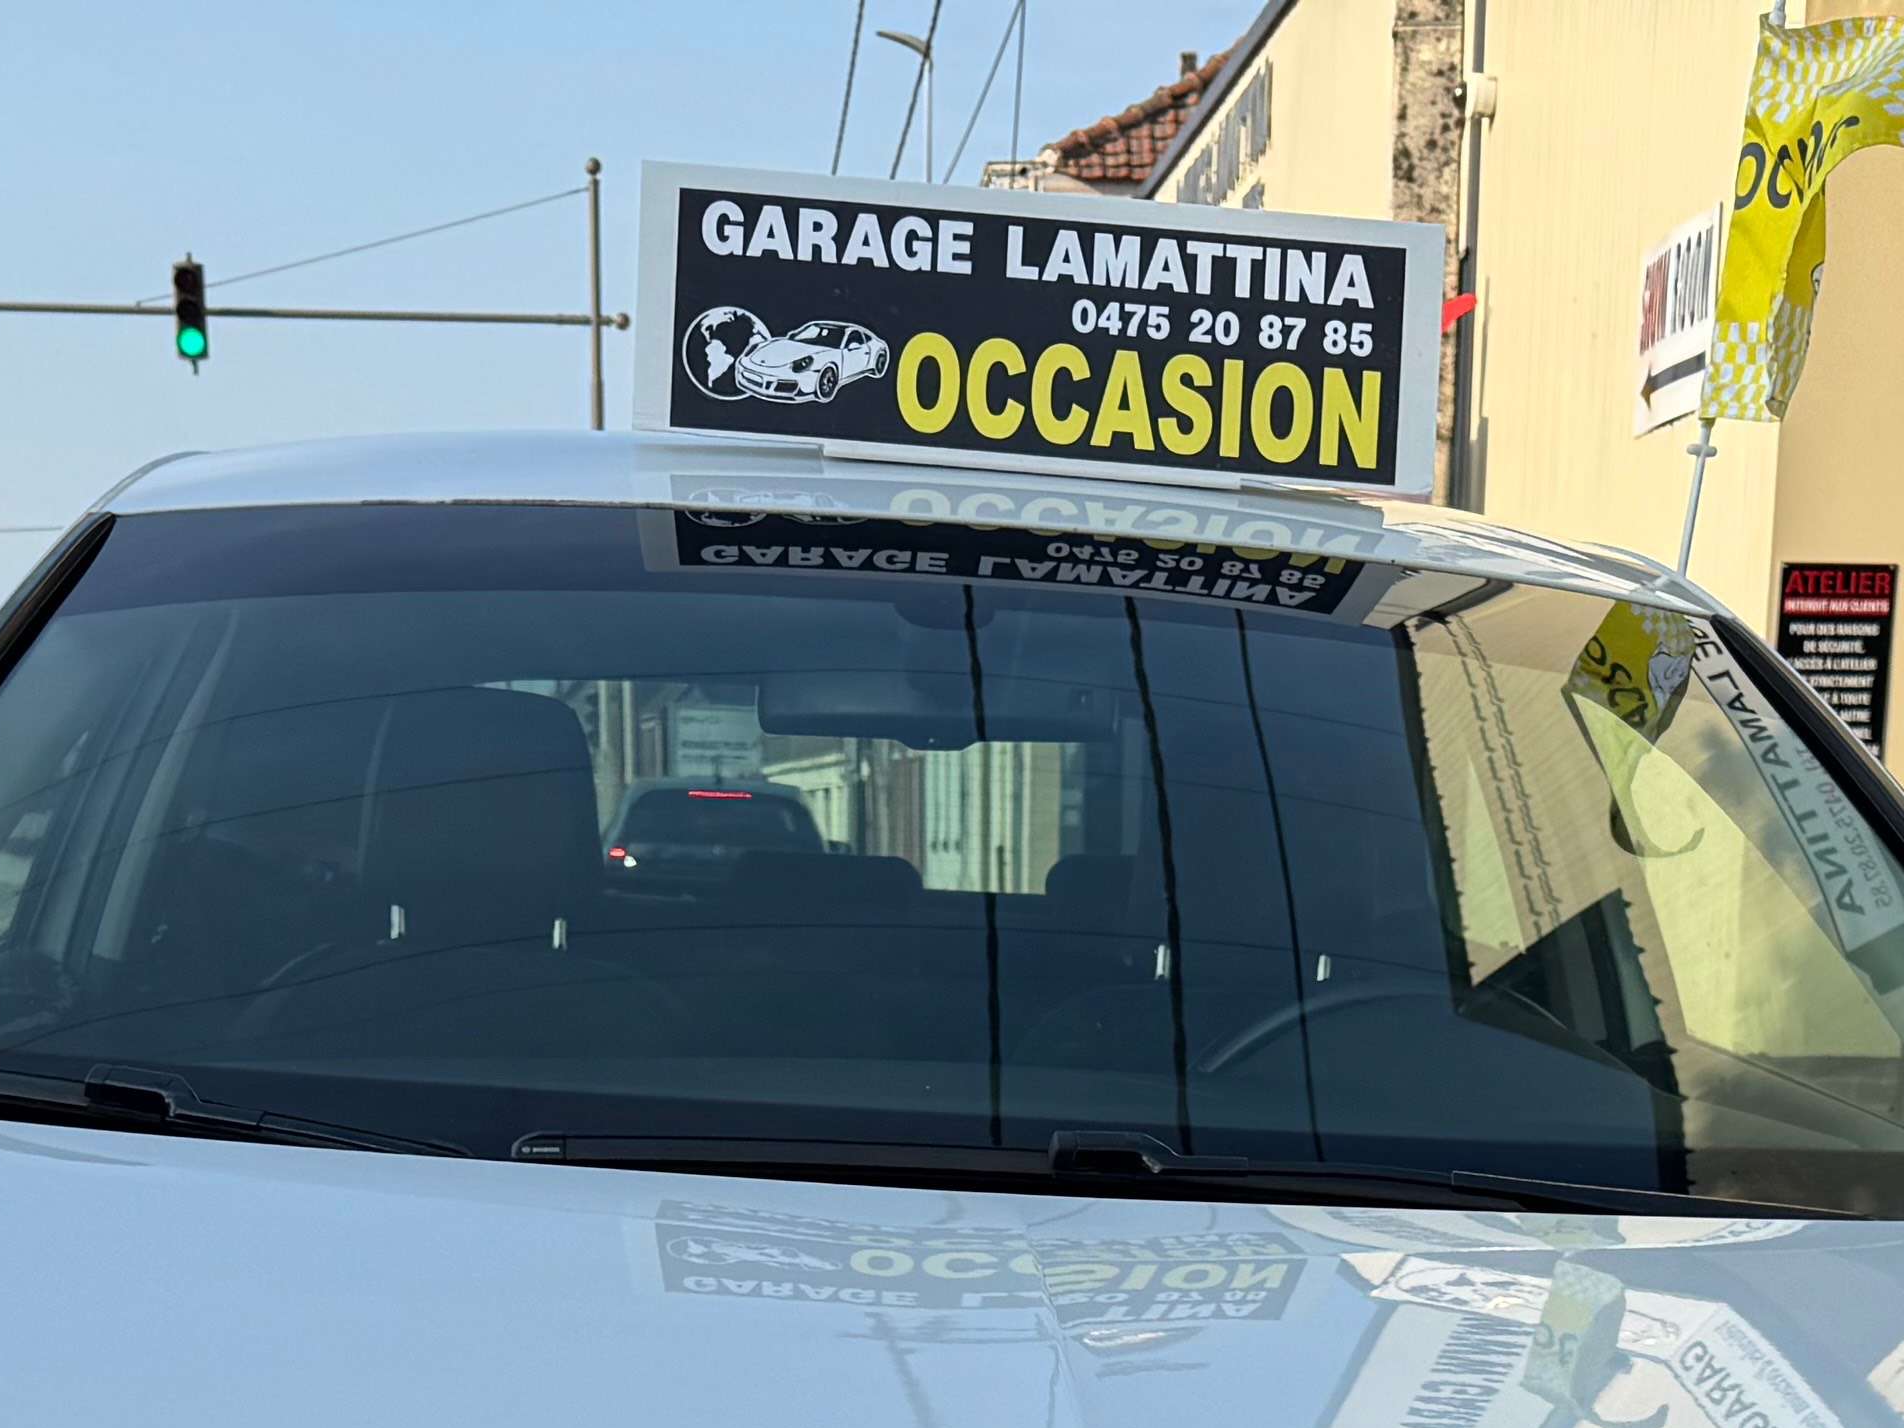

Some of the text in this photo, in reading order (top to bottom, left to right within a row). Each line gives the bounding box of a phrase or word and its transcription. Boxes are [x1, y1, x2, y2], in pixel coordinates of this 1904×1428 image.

[700, 200, 1375, 310] GARAGE LAMATTINA
[1071, 298, 1373, 357] 0475 20 87 85
[896, 331, 1382, 471] OCCASION
[1784, 570, 1892, 594] ATELIER
